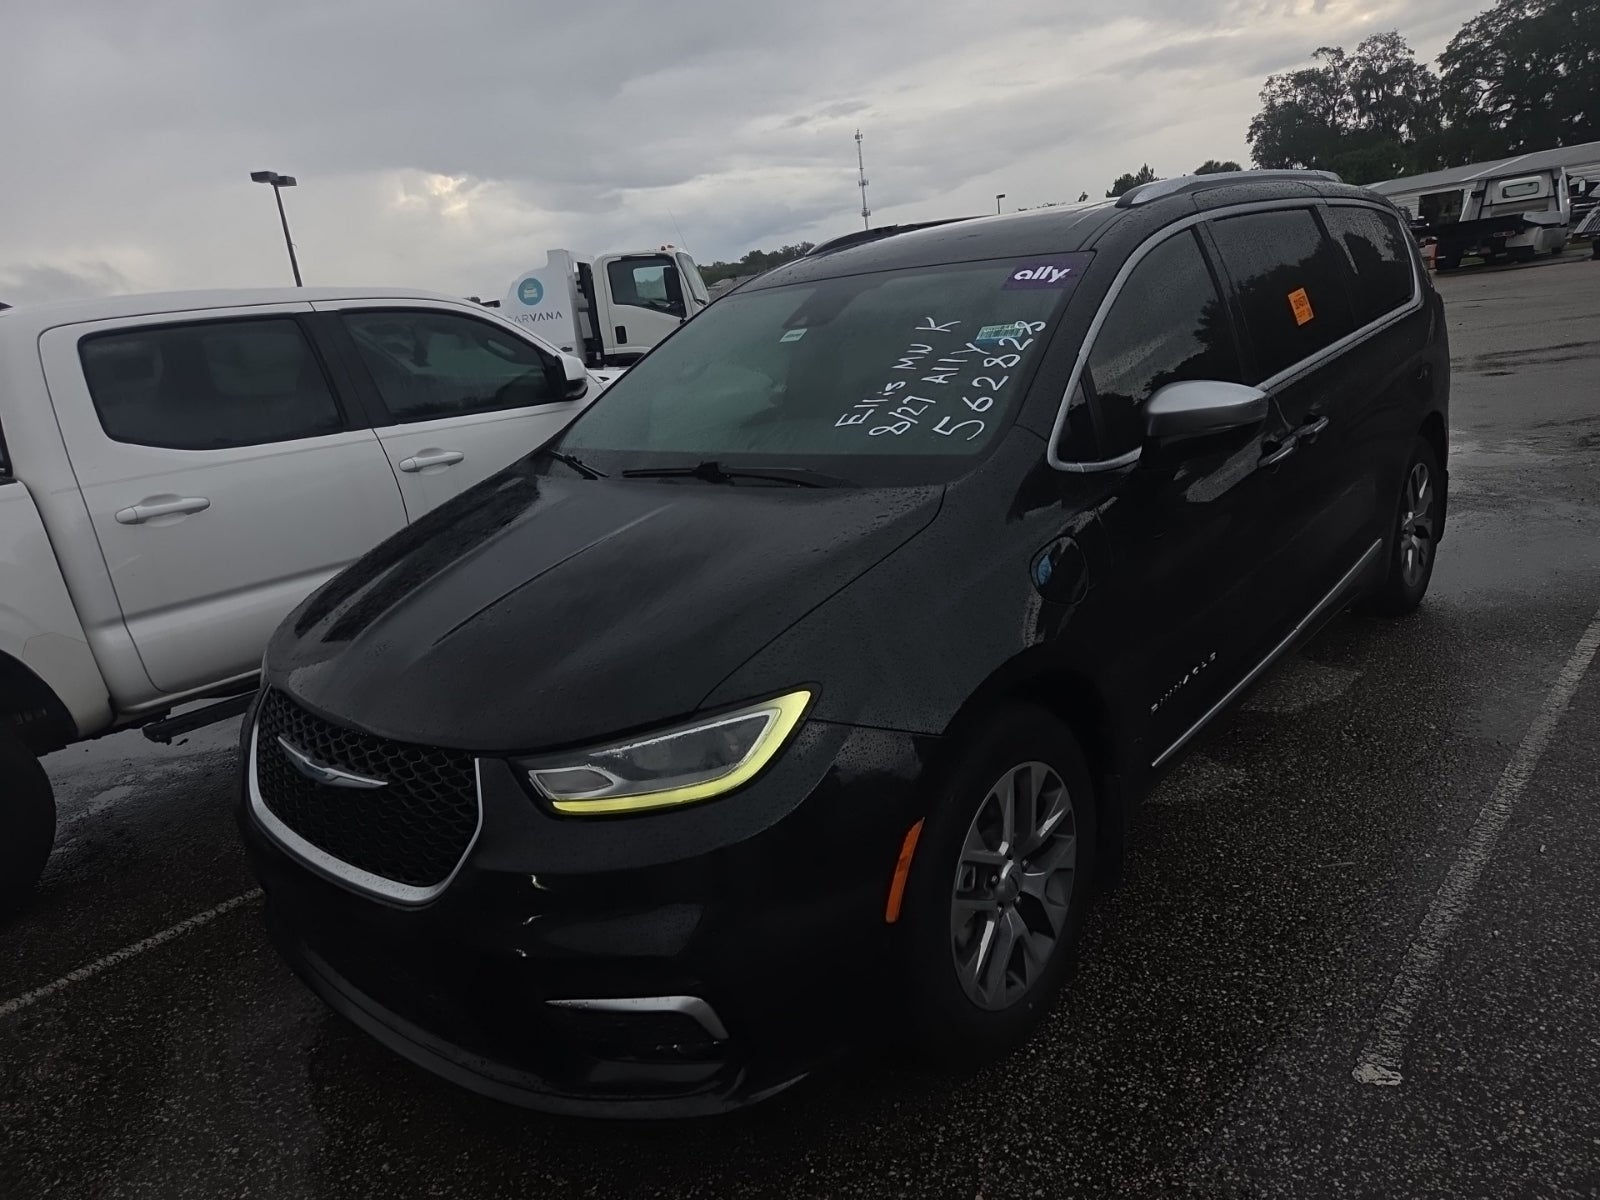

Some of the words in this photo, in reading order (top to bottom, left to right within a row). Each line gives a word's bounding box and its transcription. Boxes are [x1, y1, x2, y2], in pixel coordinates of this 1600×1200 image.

[1014, 265, 1071, 283] ally
[932, 320, 1046, 441] 562828
[834, 381, 906, 427] Ellis
[868, 395, 937, 436] 8/27
